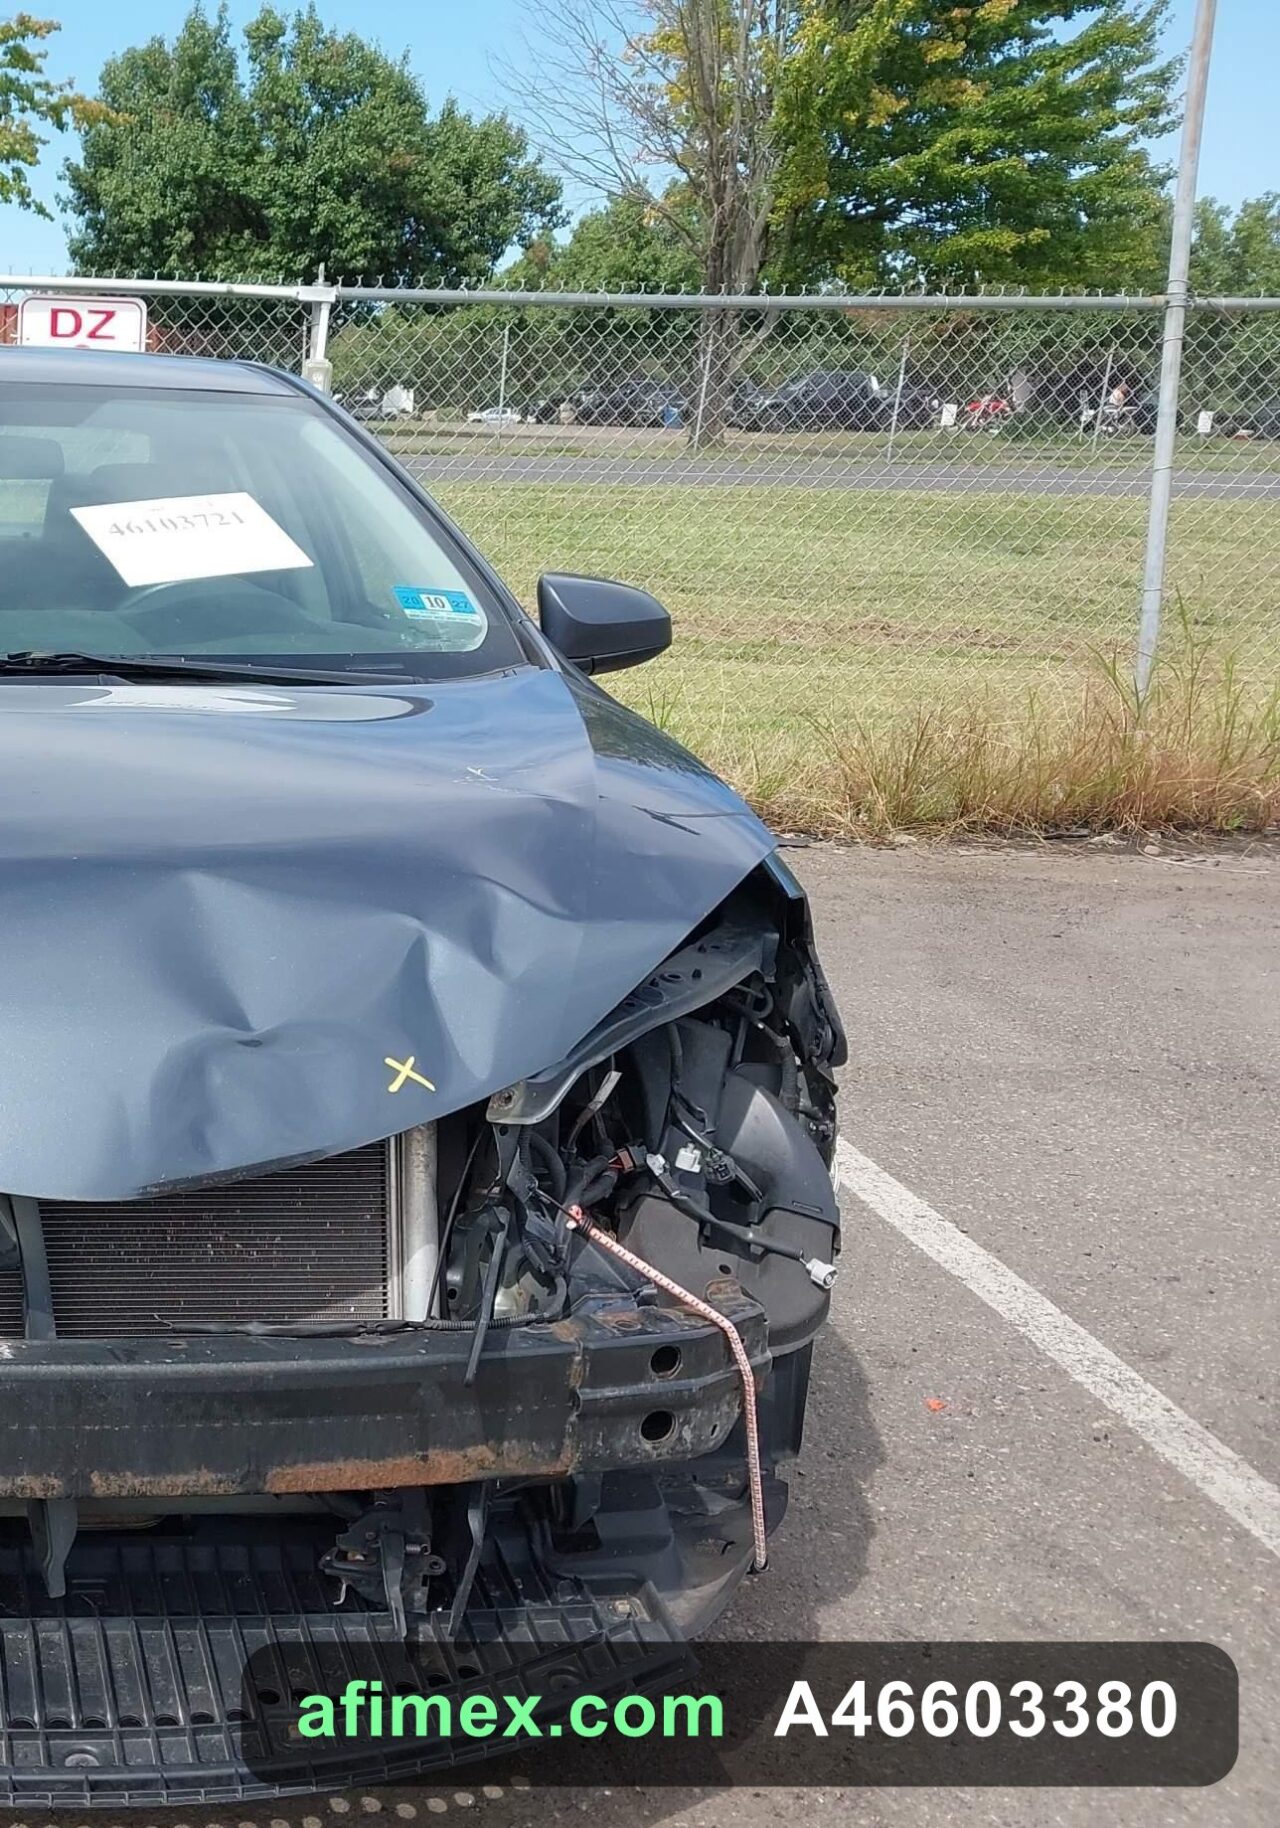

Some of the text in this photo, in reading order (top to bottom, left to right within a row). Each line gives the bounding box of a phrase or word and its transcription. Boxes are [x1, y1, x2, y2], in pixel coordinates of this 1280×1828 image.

[50, 307, 116, 340] DZ
[108, 510, 246, 537] 46103721
[424, 595, 446, 610] 10
